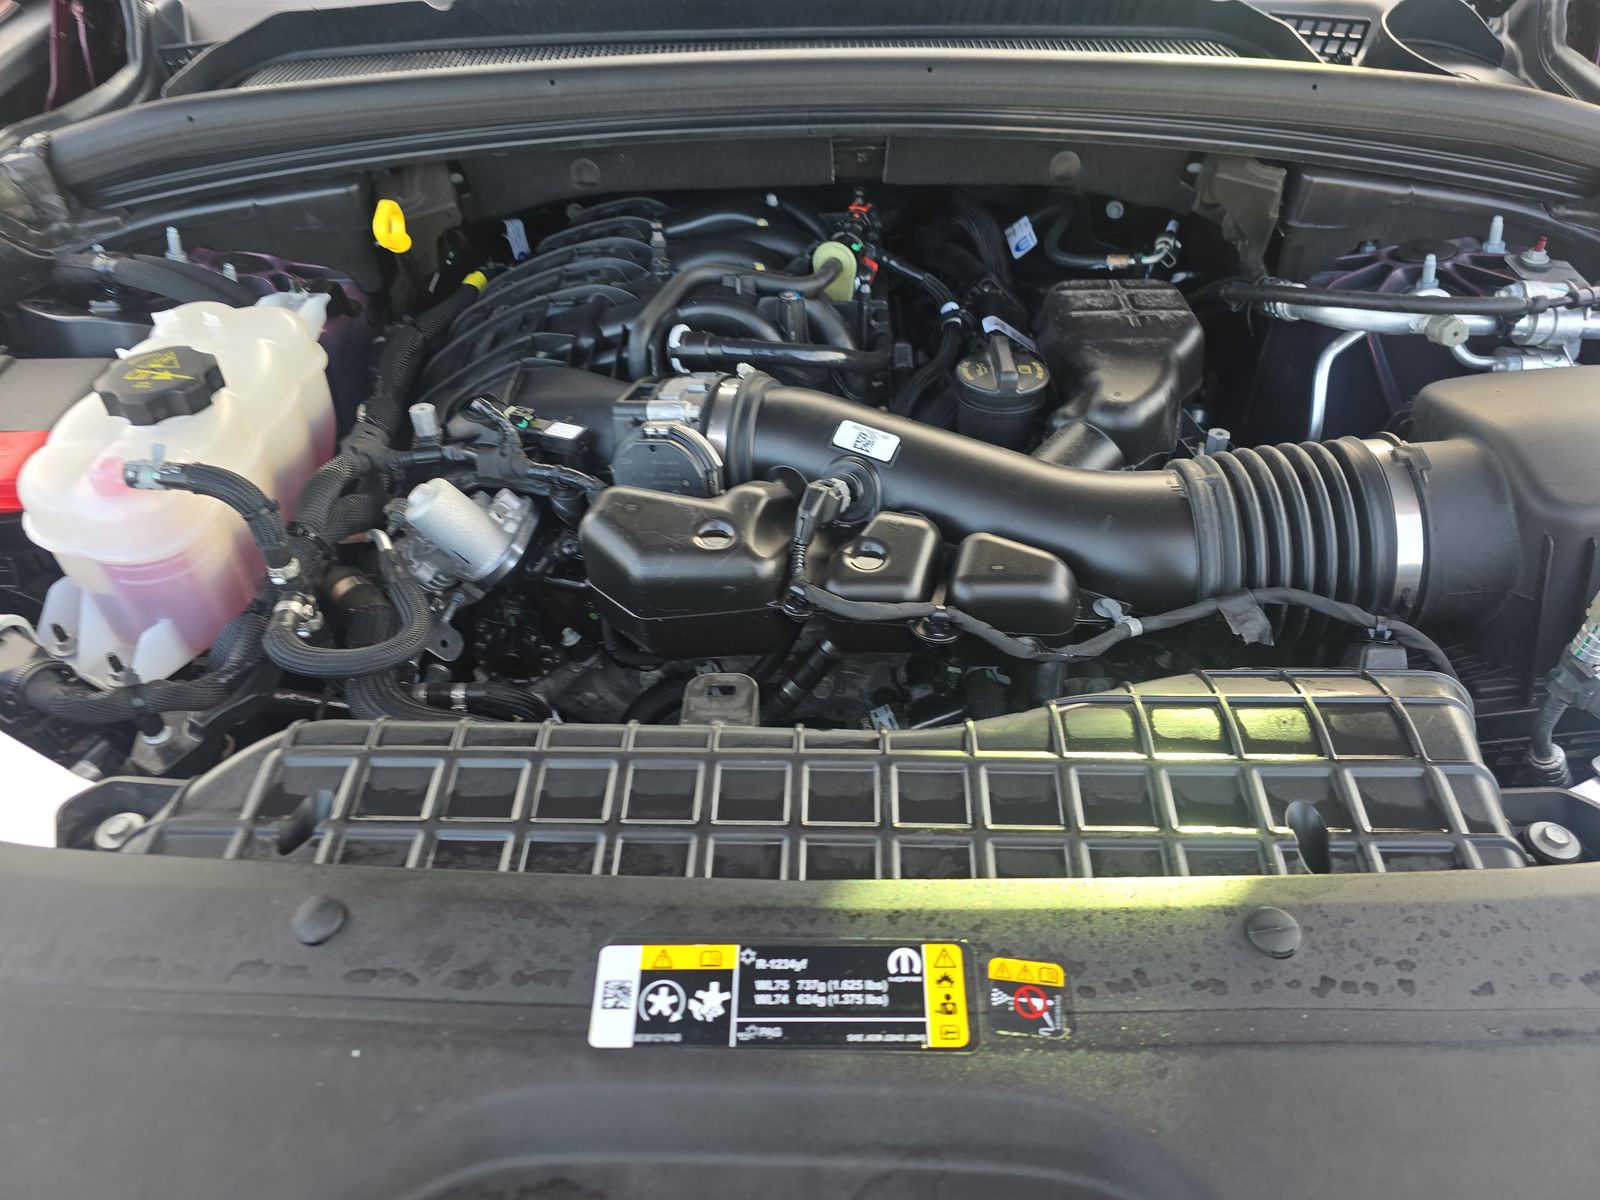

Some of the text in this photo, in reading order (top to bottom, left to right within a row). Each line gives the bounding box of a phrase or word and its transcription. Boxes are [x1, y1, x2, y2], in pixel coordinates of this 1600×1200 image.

[754, 979, 790, 990] WL75
[796, 979, 826, 993] 737g
[864, 979, 889, 993] lbs)
[753, 993, 790, 1005] WL74
[827, 993, 863, 1007] (1.375
[864, 993, 889, 1007] lbs)
